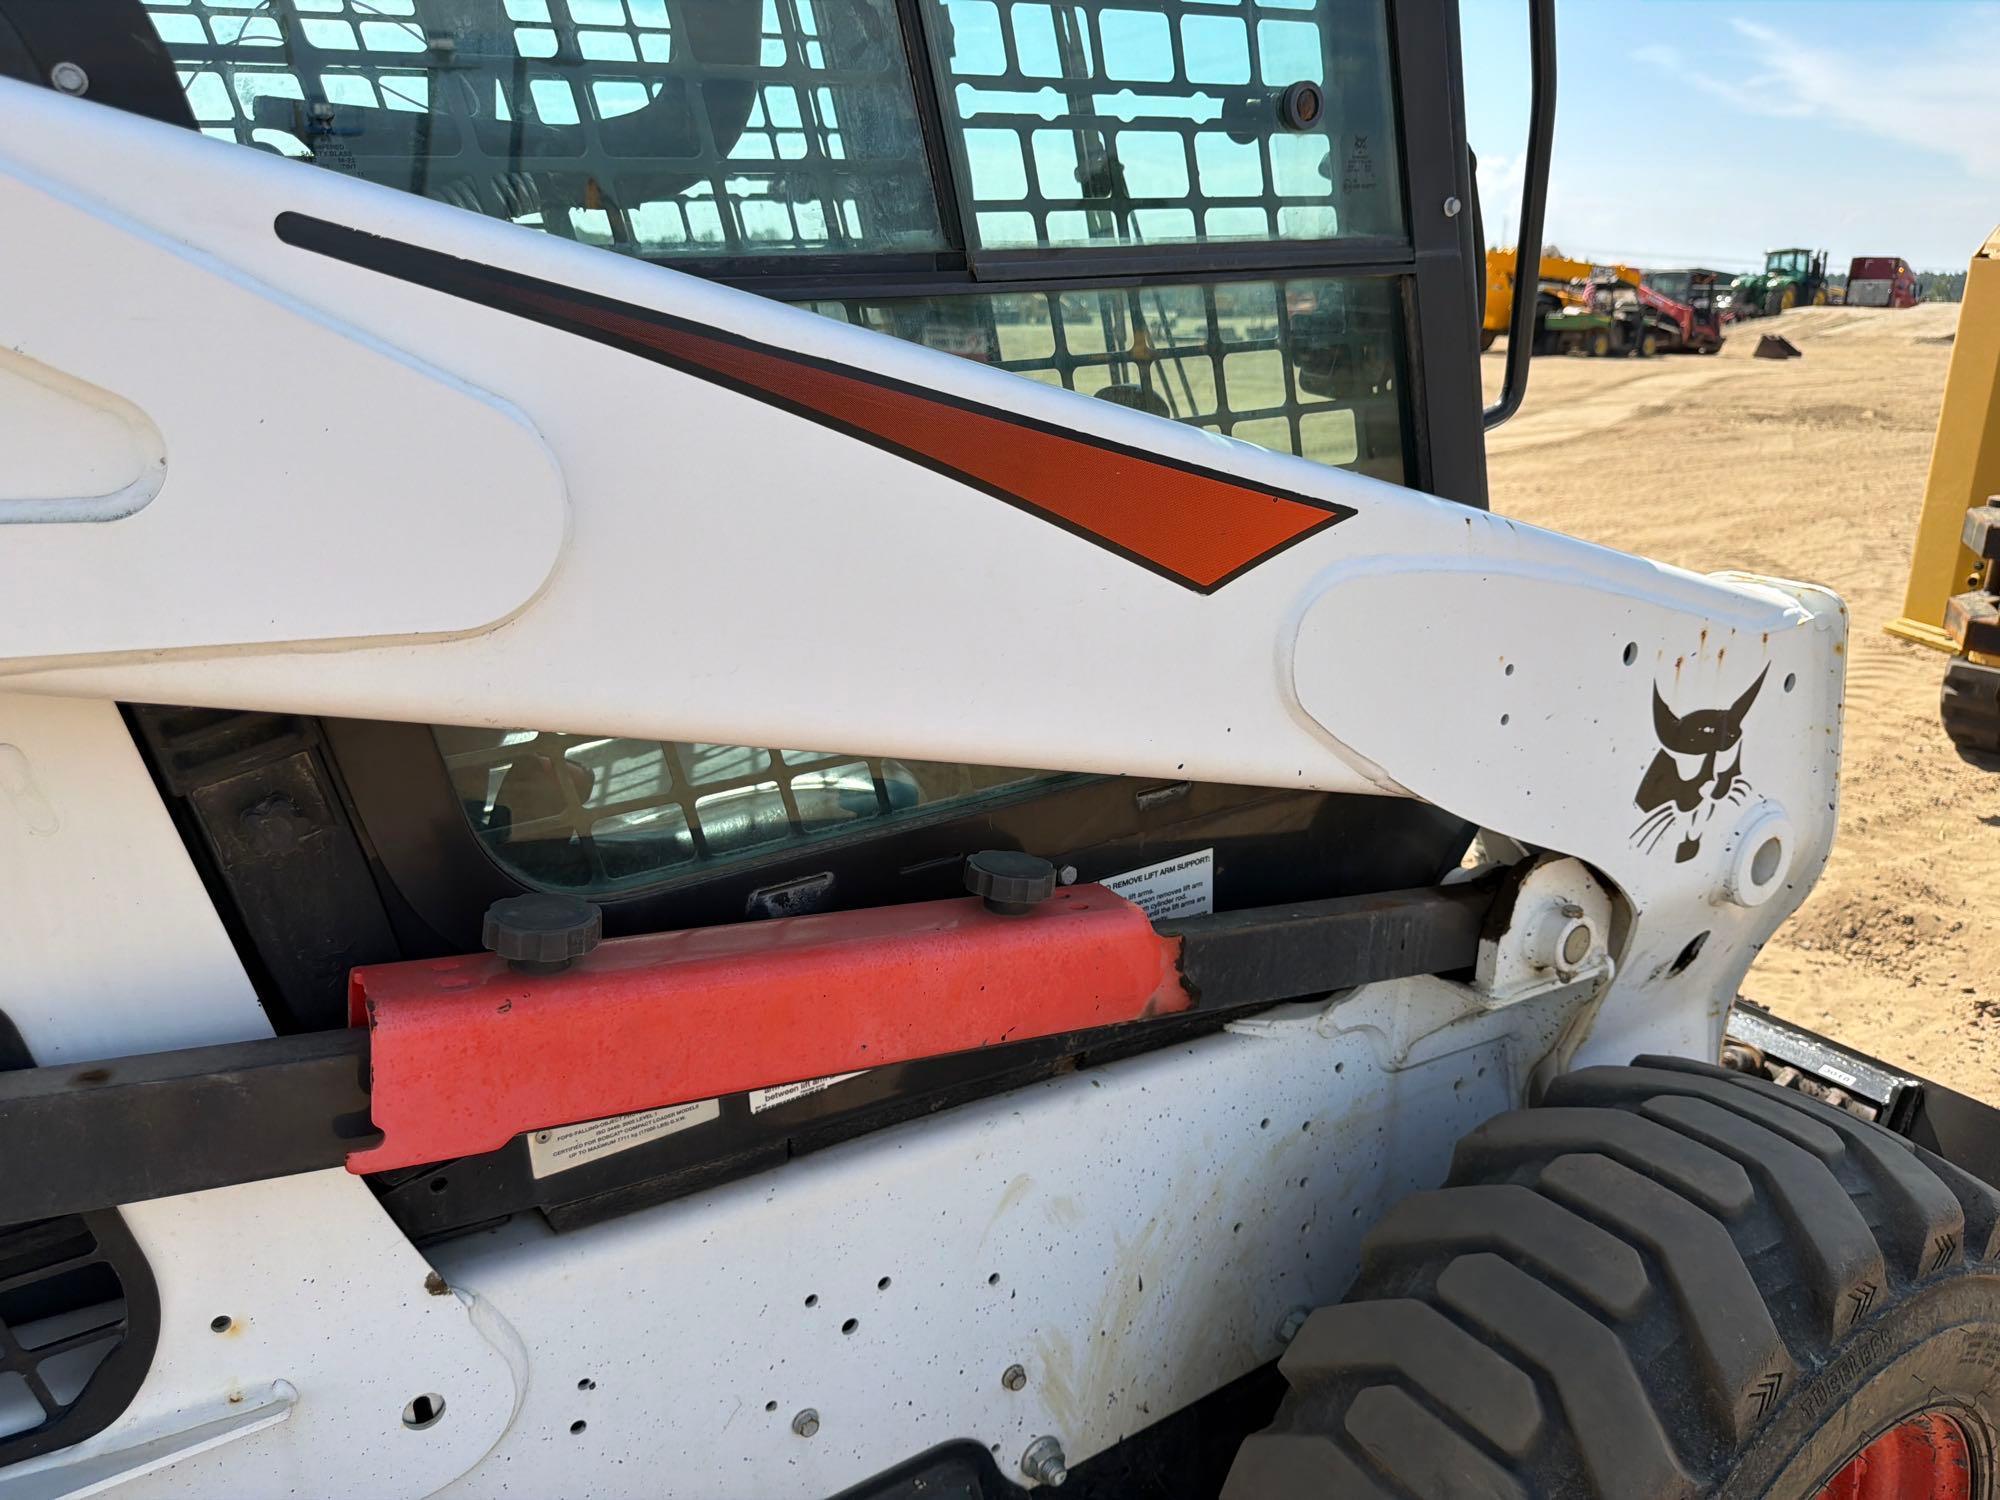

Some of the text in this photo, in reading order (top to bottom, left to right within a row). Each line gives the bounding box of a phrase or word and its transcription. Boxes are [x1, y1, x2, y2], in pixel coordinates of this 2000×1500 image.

[1112, 876, 1143, 889] REMOVE
[1144, 871, 1158, 881] LIFT
[1159, 865, 1176, 876] ARM
[1177, 855, 1211, 871] SUPPORT:
[1128, 891, 1137, 900] lift
[1137, 888, 1154, 898] arms.
[1156, 888, 1182, 901] removes
[1183, 883, 1191, 891] lift
[1192, 881, 1203, 889] arm
[1150, 897, 1174, 911] cylinder
[1175, 893, 1187, 903] rod.
[1160, 906, 1171, 914] the
[1172, 902, 1180, 910] lift
[1180, 898, 1195, 908] arms
[1197, 895, 1206, 904] are
[765, 1085, 799, 1102] between
[636, 1114, 653, 1122] LEVEL
[552, 1143, 583, 1157] CERTIFIED
[584, 1138, 596, 1147] FOR
[624, 1119, 652, 1133] COMPACT
[652, 1112, 676, 1124] LOADER
[676, 1104, 699, 1115] MODELS
[587, 1139, 616, 1152] MAXIMUM
